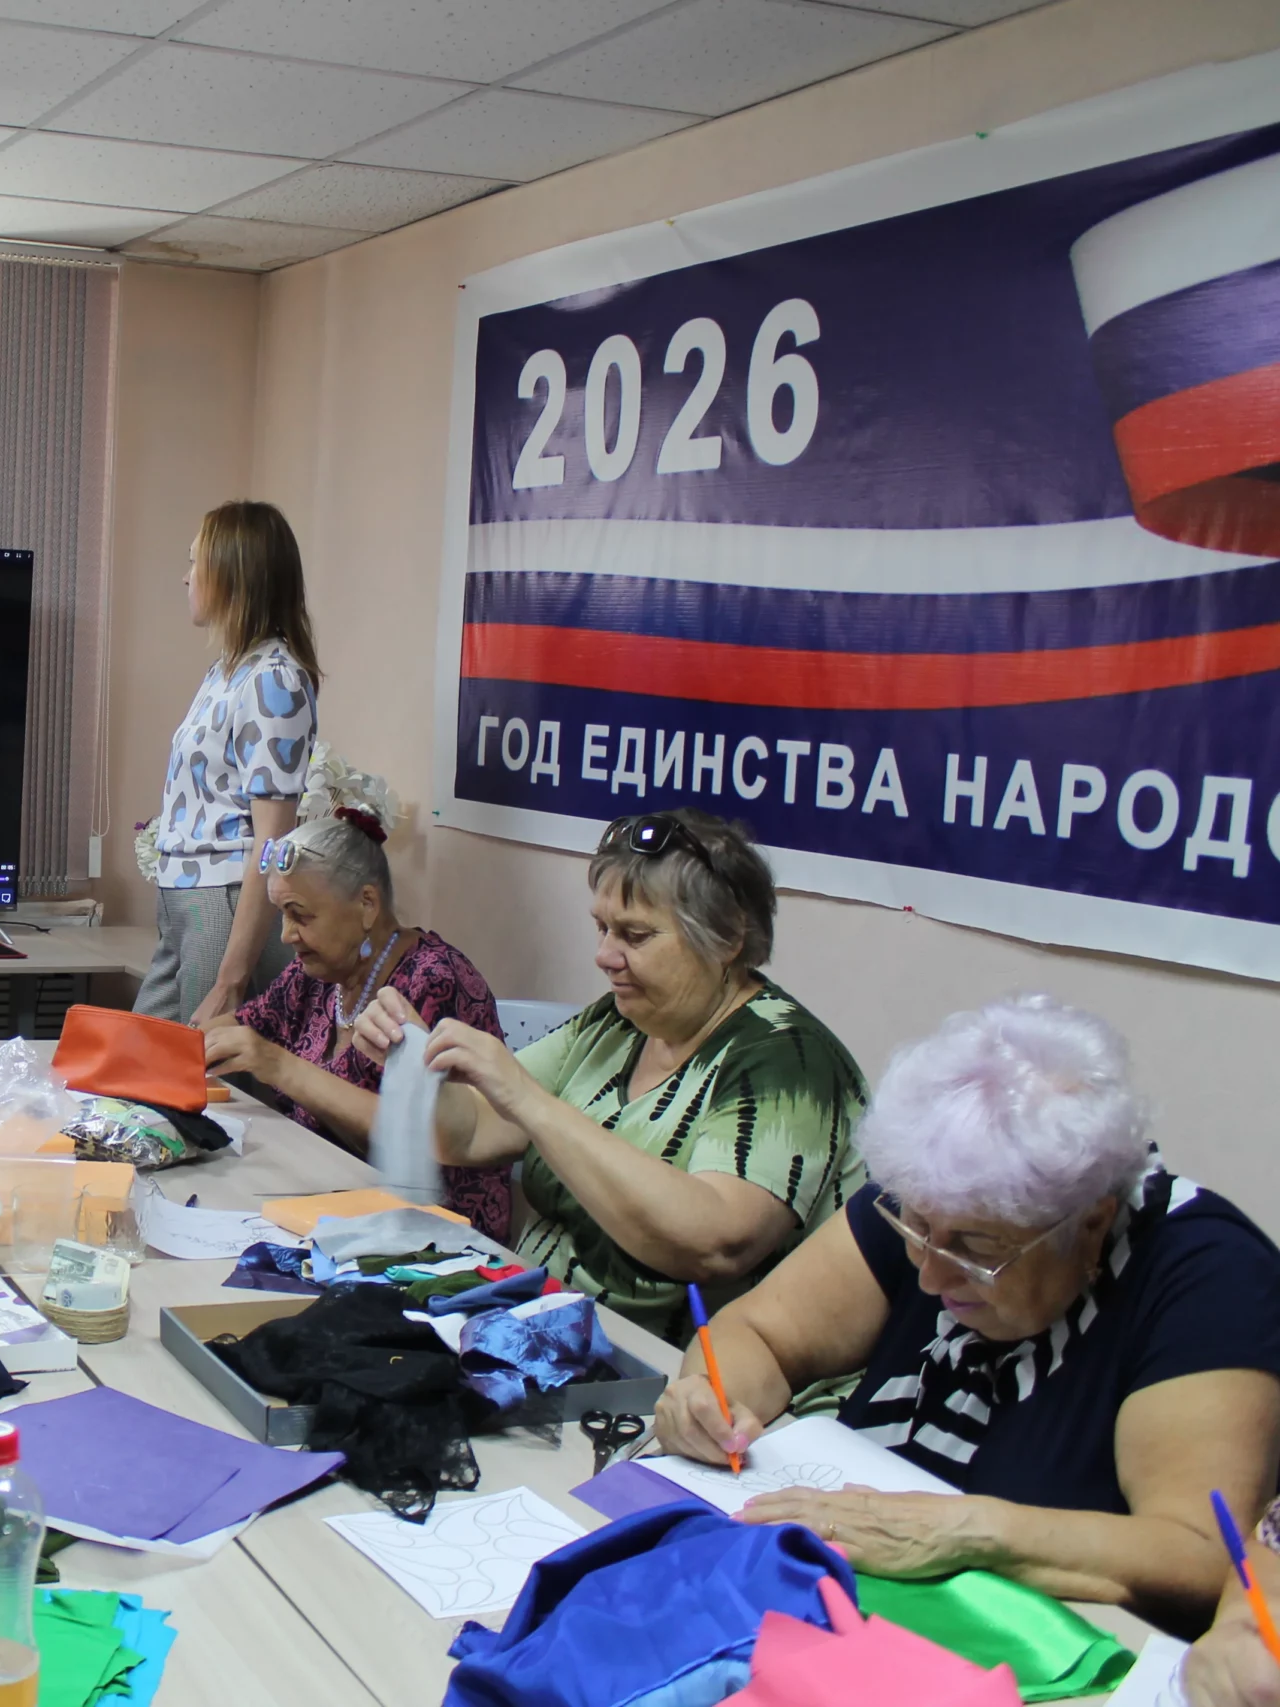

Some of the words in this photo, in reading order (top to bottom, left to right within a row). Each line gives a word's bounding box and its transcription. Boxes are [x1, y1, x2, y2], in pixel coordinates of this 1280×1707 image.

[513, 298, 821, 490] 2026
[477, 715, 561, 787] ГОД
[581, 723, 909, 818] ЕДИНСТВА
[943, 752, 1280, 878] НАРОД
